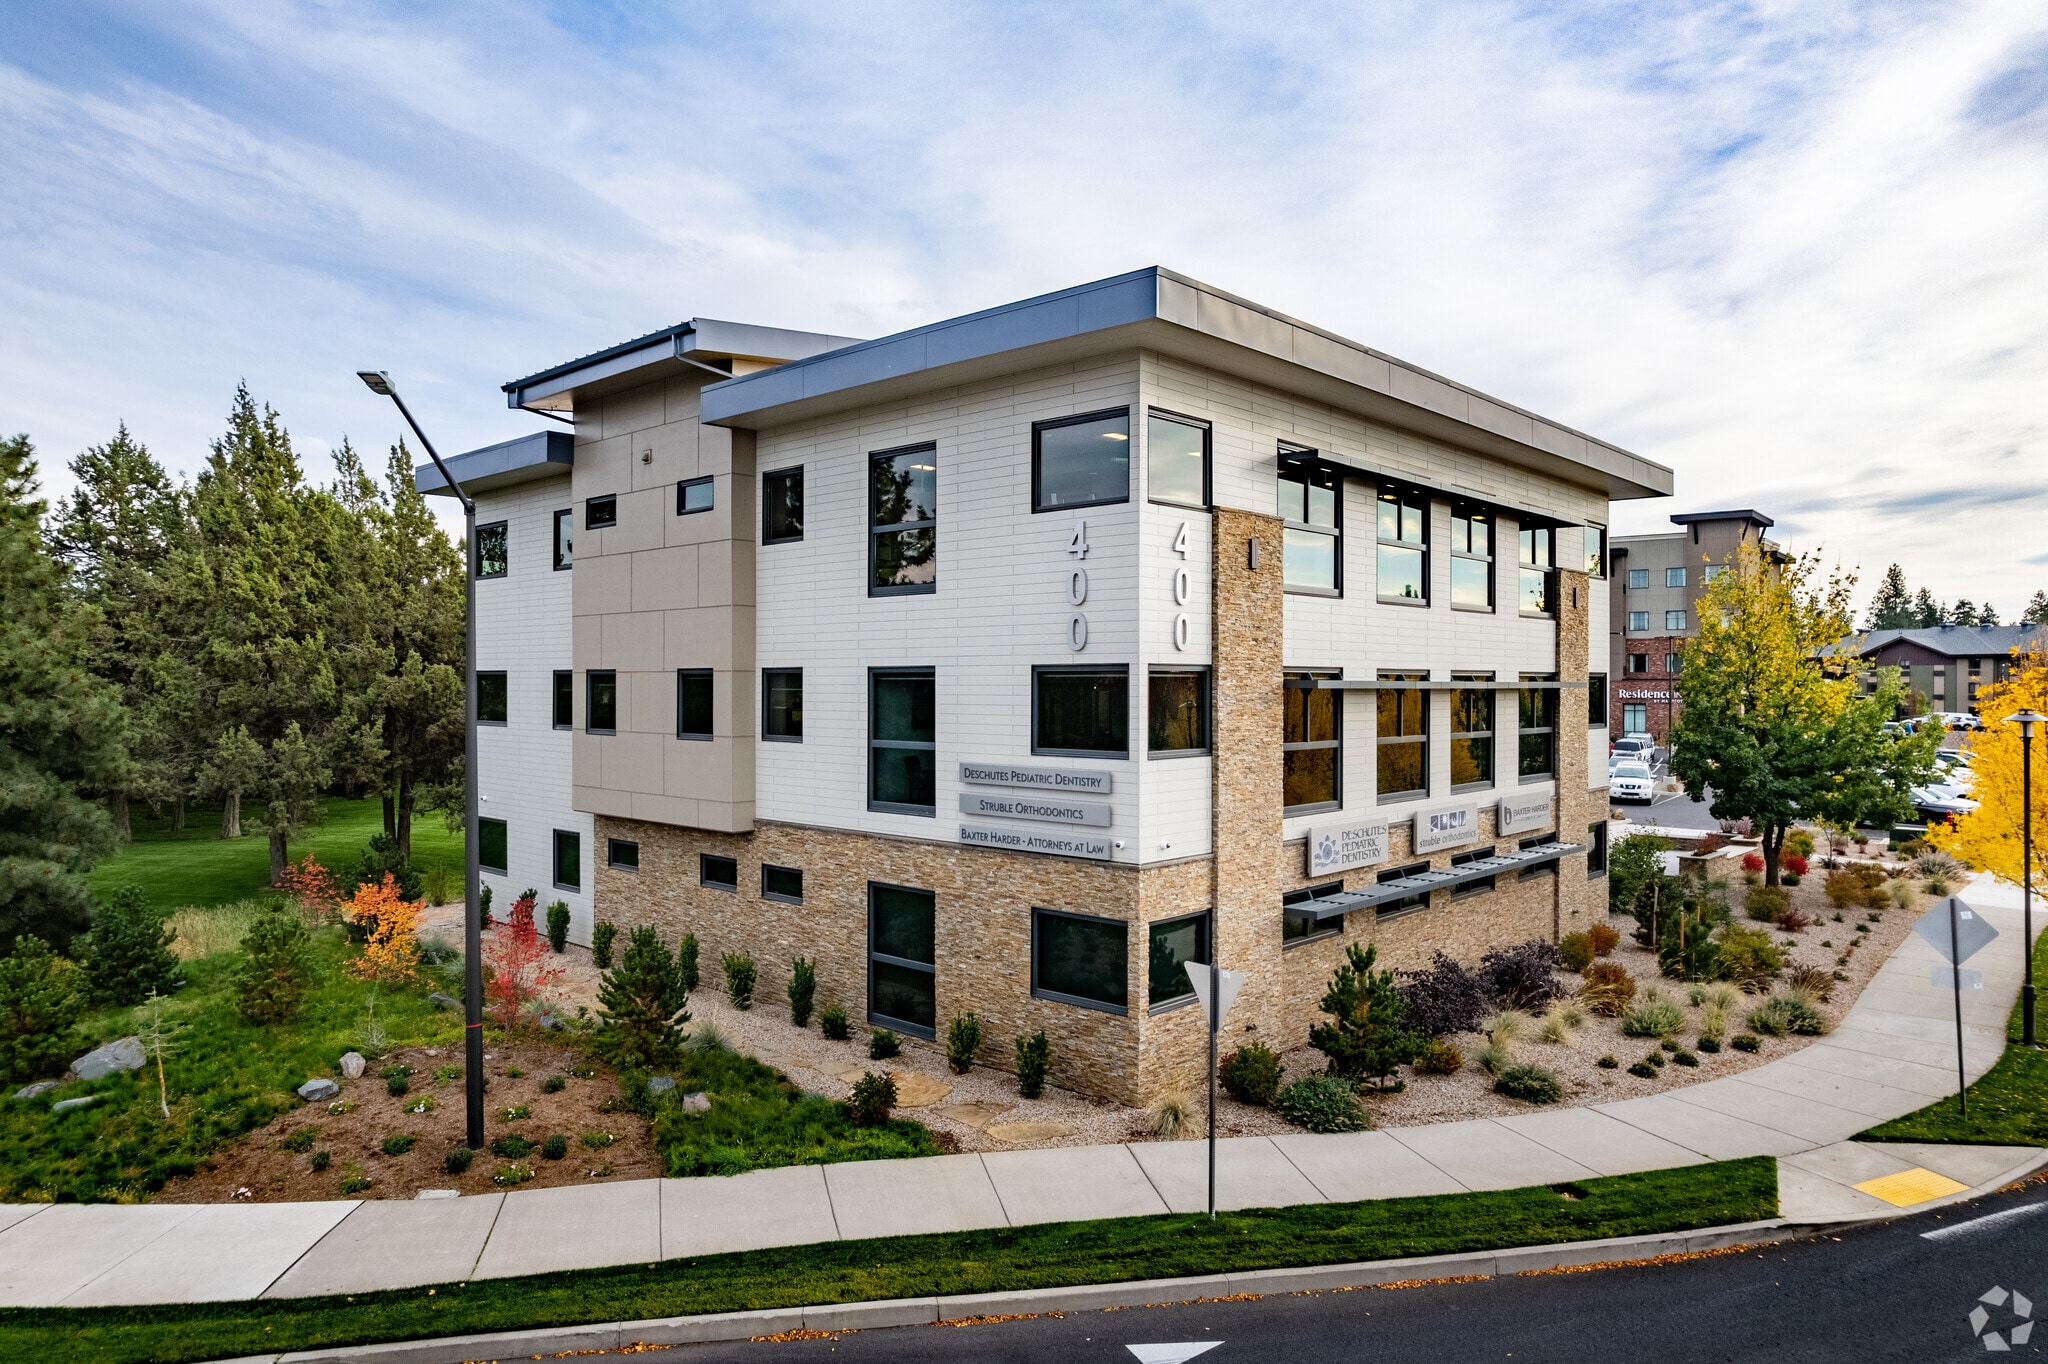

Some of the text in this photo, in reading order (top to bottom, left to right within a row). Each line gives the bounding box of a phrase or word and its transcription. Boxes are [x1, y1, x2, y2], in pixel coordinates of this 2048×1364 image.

[1067, 521, 1090, 651] 400
[1172, 521, 1193, 651] 400
[1618, 689, 1683, 699] Residence IN
[964, 767, 1102, 788] DESCHUTES PEDIATRIC DENTISTRY
[979, 800, 1084, 820] STRUBLE ORTHODONTICS
[961, 828, 989, 842] BAXTER
[990, 831, 1021, 846] HARDER
[1027, 836, 1073, 851] ATTORNEYS
[1086, 842, 1104, 855] LAW
[1341, 824, 1387, 841] DESCHUTES
[1420, 829, 1477, 848] struble orthodontics
[1341, 836, 1380, 853] PEDIATRIC
[1341, 847, 1382, 864] DENTISTRY
